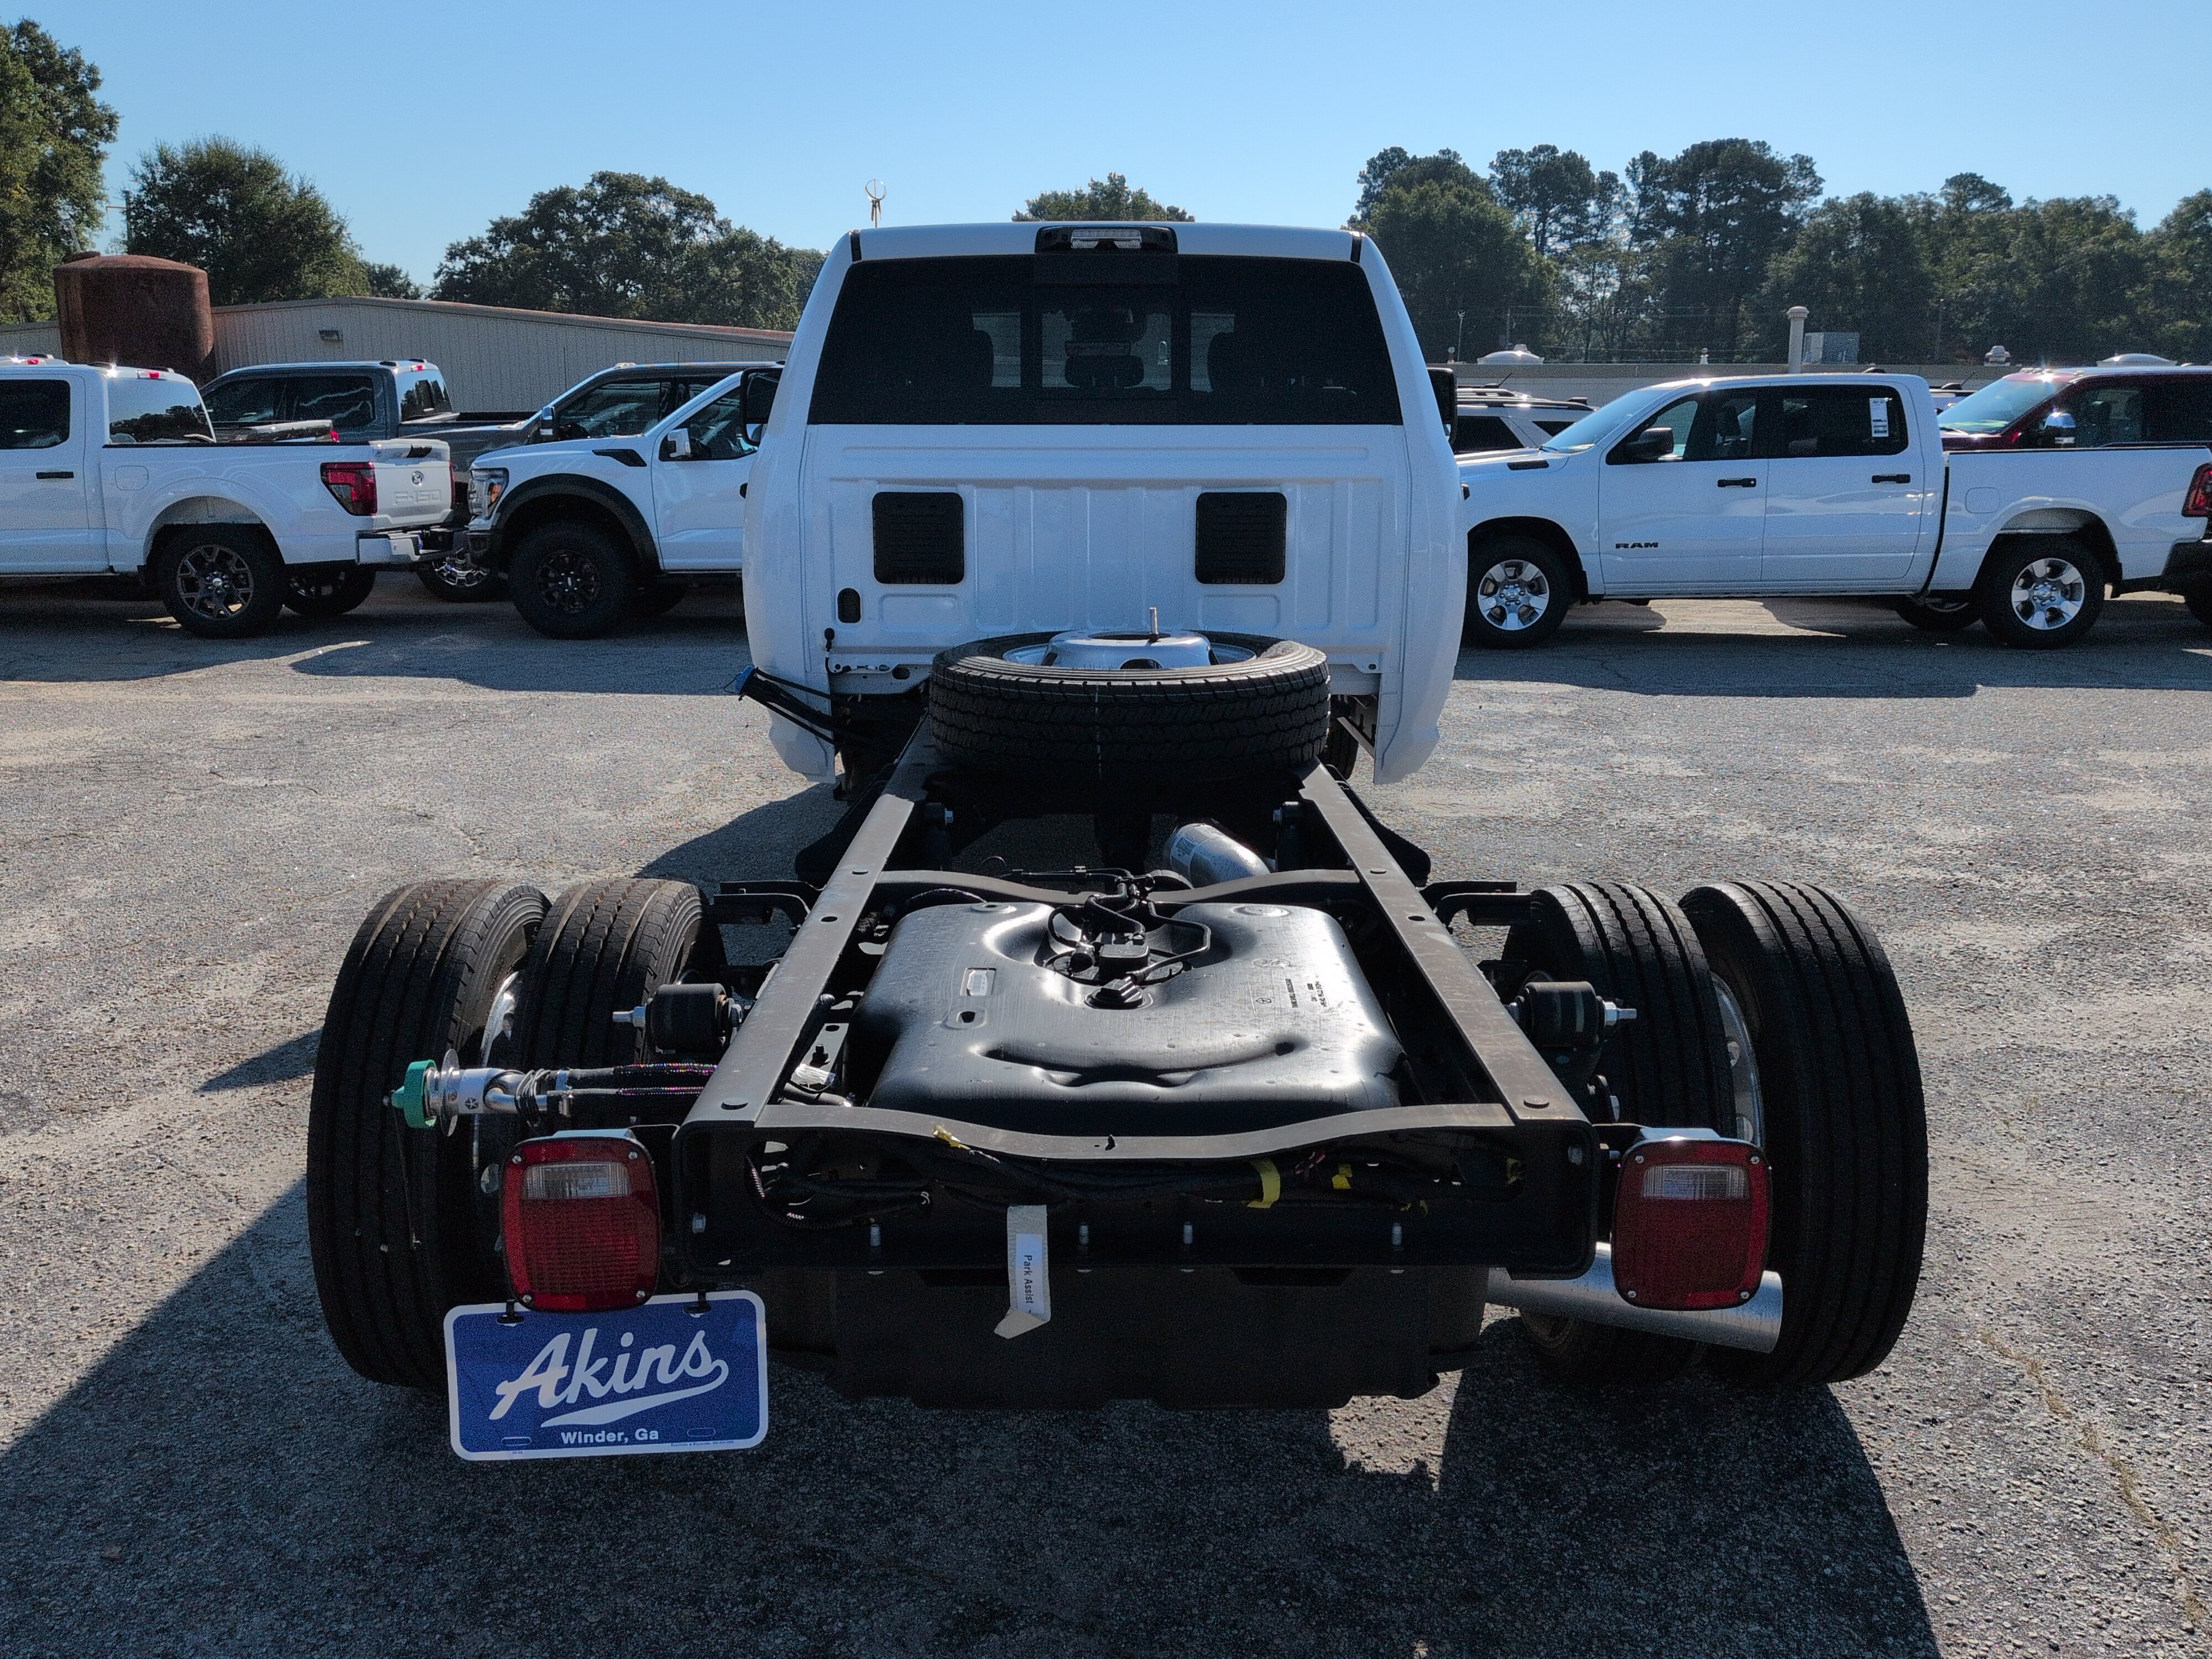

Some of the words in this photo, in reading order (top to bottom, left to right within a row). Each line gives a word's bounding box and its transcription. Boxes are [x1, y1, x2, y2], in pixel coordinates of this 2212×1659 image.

[393, 489, 442, 505] F-150
[1024, 1255, 1033, 1276] Park
[1024, 1278, 1034, 1303] Assist
[489, 1327, 728, 1420] Akins
[561, 1430, 629, 1444] Winder,
[635, 1428, 659, 1441] Ga
